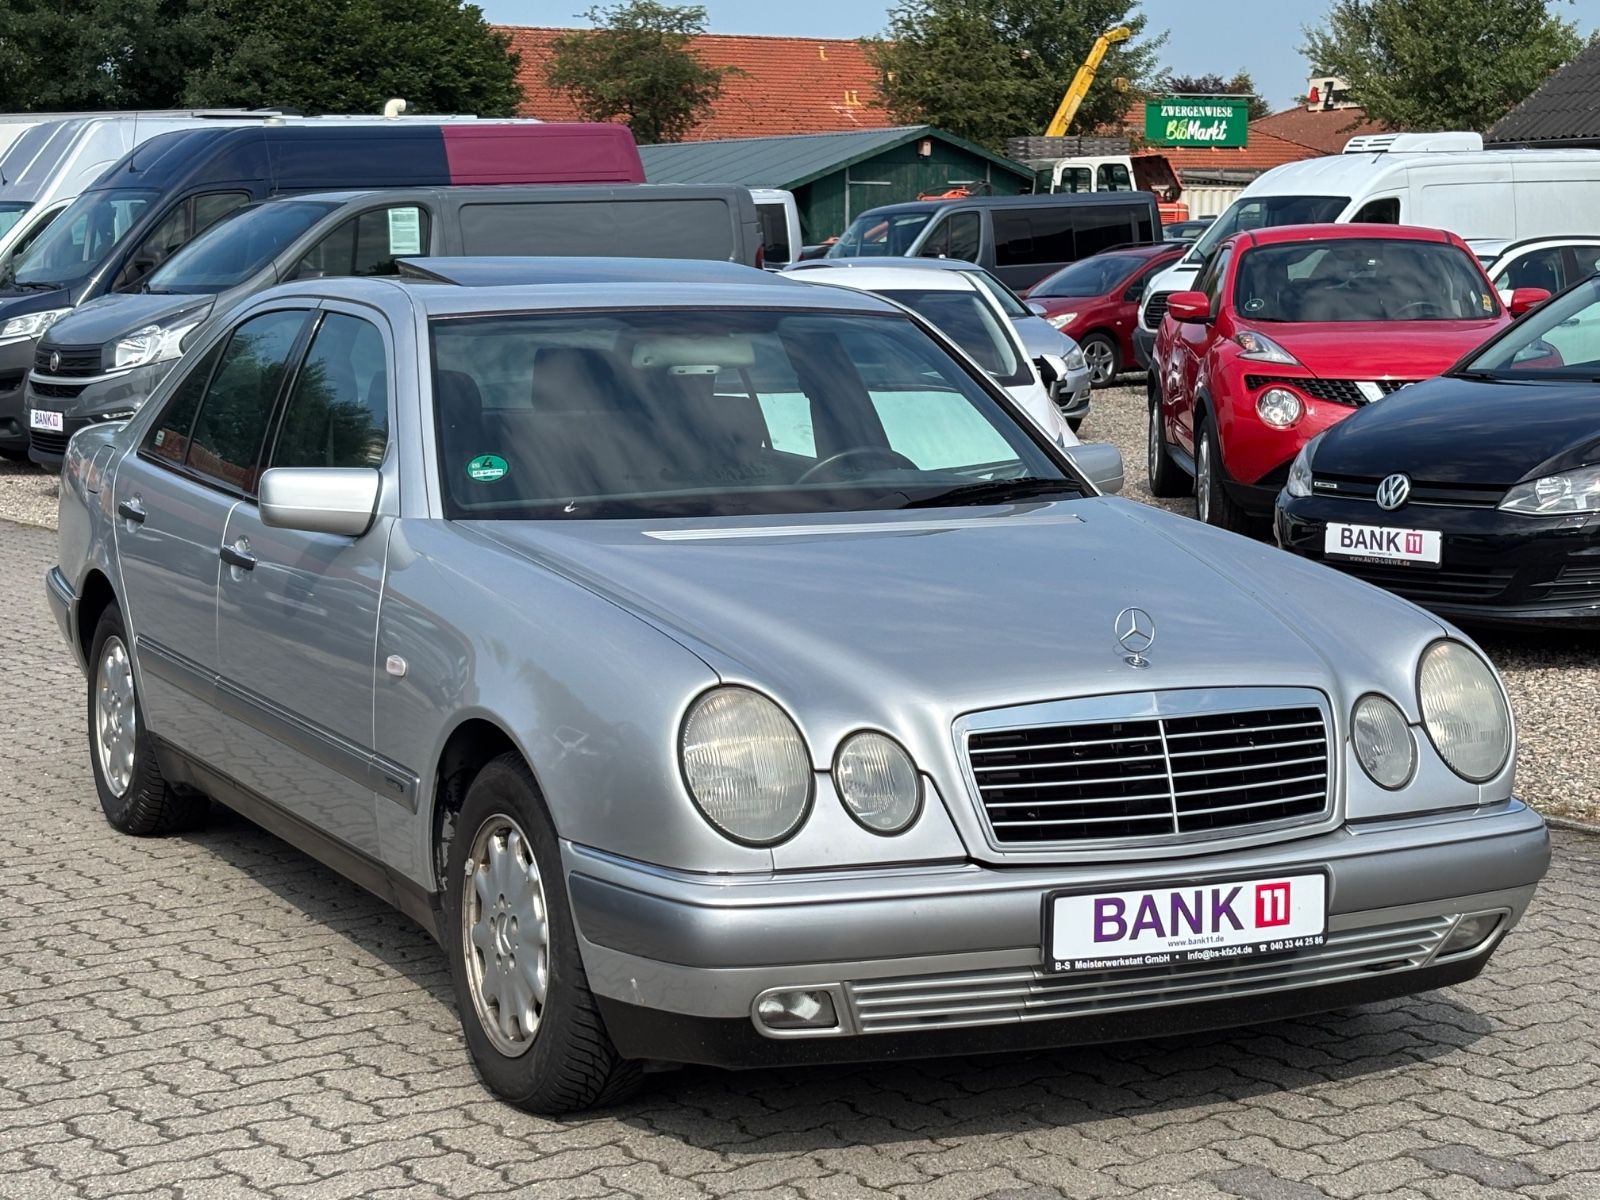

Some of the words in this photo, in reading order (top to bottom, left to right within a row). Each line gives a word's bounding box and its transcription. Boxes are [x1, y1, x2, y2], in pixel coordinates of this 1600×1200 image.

[1161, 106, 1233, 117] ZWERGENWIESE
[1166, 119, 1228, 140] BioMarkt
[35, 412, 52, 426] BANK
[482, 456, 494, 469] 4
[1340, 527, 1401, 553] BANK
[1407, 534, 1420, 552] 11
[1093, 886, 1245, 943] BANK
[1259, 887, 1287, 923] 11
[1167, 935, 1225, 947] www.bank11.de
[1055, 961, 1071, 971] B-S
[1075, 955, 1143, 970] Meisterwerkstatt
[1145, 953, 1170, 964] GmbH
[1270, 941, 1283, 951] 040
[1284, 939, 1293, 949] 33
[1295, 938, 1304, 947] 44
[1305, 937, 1313, 946] 25
[1314, 935, 1324, 945] 86
